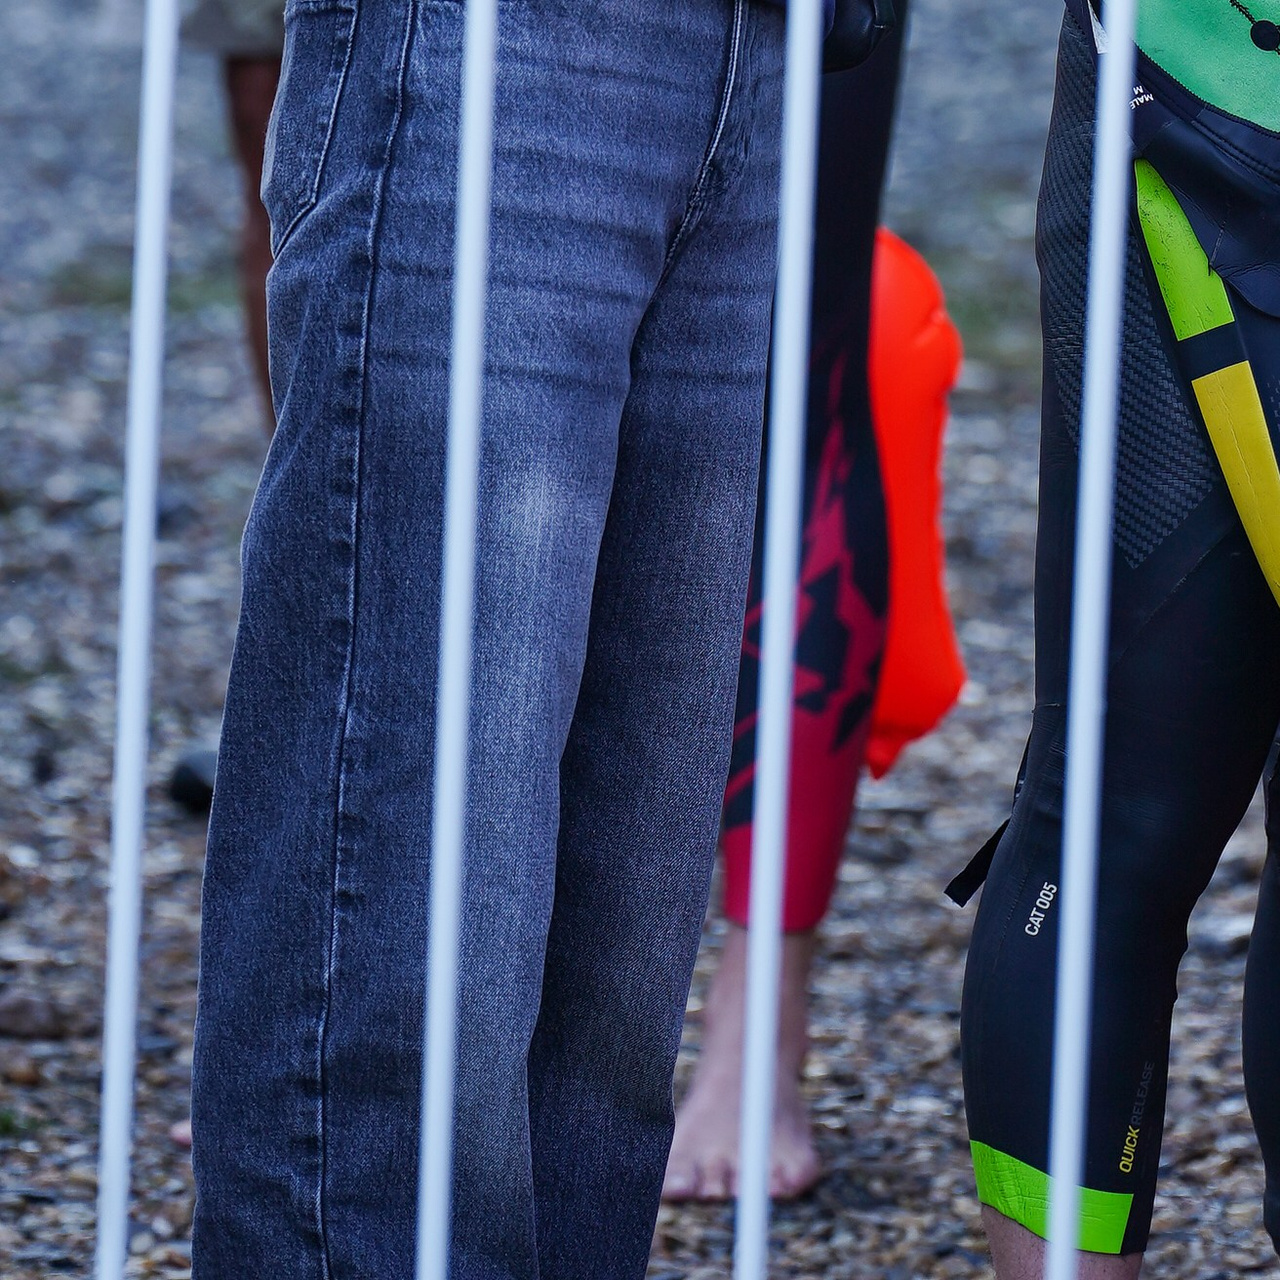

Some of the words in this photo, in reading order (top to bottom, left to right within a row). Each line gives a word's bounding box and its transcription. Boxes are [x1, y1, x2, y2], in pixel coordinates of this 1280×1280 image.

[1129, 94, 1154, 110] MALE
[1025, 907, 1045, 936] CAT
[1036, 882, 1057, 909] 005
[1119, 1125, 1140, 1173] QUICK
[1131, 1061, 1155, 1126] RELEASE
